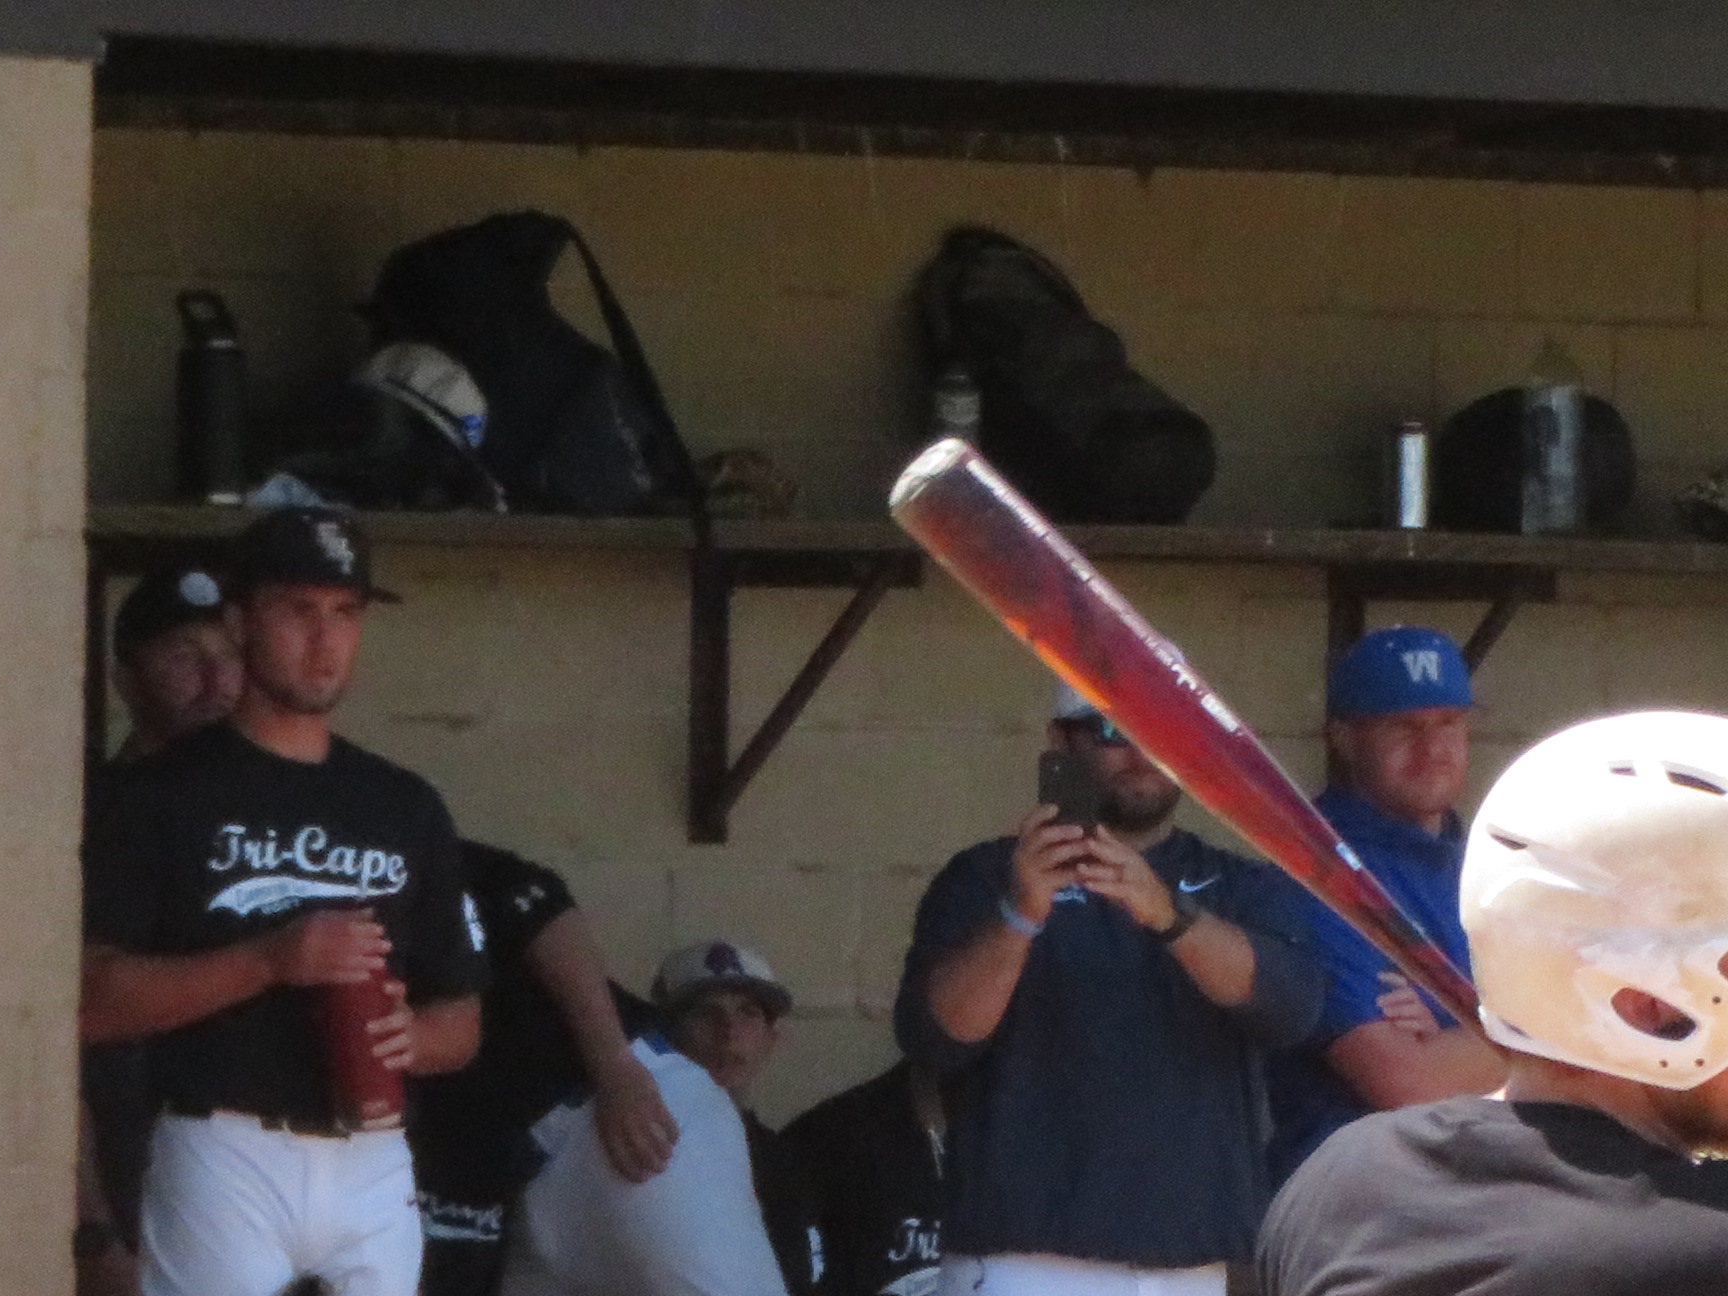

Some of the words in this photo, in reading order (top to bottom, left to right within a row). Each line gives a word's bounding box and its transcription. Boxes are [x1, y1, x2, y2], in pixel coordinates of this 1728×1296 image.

[1402, 650, 1438, 682] W
[208, 824, 409, 895] Tri-Cape
[886, 1218, 942, 1261] Tri
